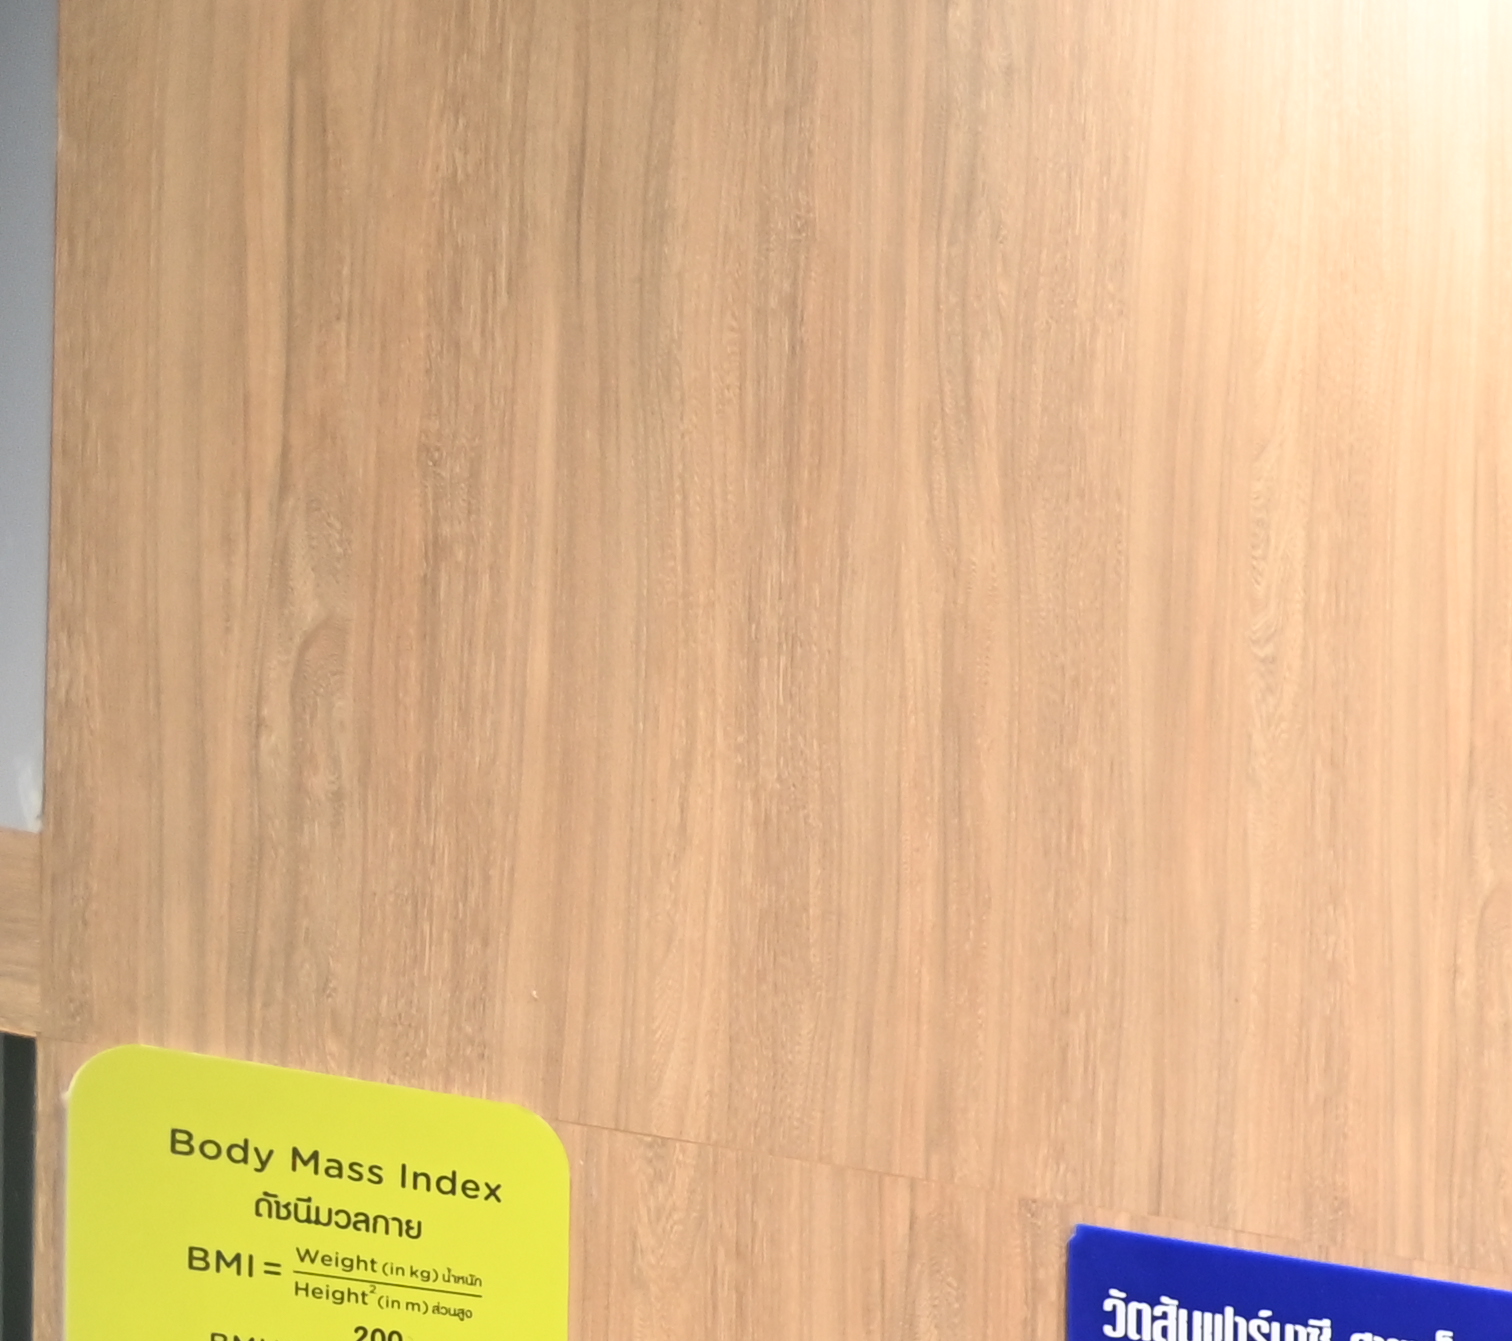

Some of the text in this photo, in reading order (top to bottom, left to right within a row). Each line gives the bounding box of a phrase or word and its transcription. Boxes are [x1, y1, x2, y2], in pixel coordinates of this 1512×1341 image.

[170, 1128, 502, 1204] Body Mass Index
[254, 1190, 423, 1240] ดัชนีมวลกาย
[187, 1246, 254, 1278] BMI
[295, 1246, 379, 1273] Weight
